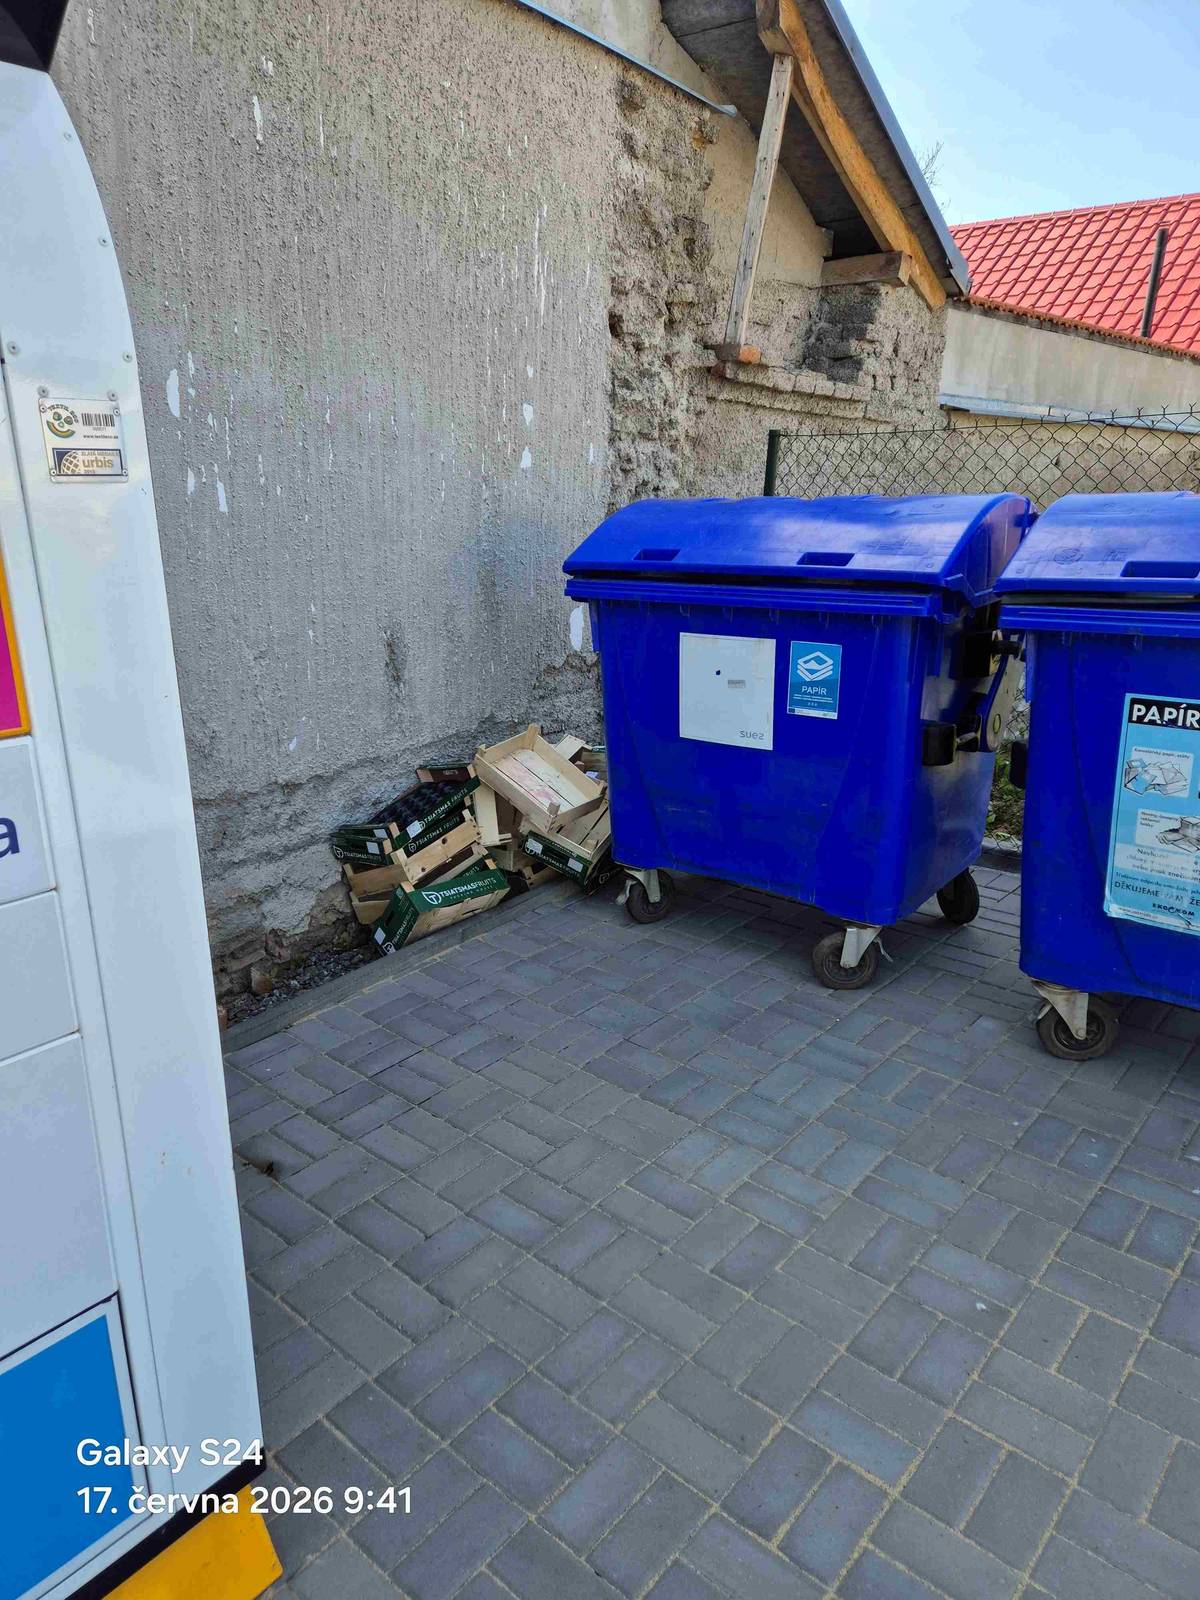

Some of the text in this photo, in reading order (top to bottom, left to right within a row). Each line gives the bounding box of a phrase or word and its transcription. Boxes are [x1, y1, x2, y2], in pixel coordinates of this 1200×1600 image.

[82, 457, 113, 468] urbis
[1132, 703, 1200, 728] PAPÍR
[739, 730, 765, 741] suez
[424, 799, 452, 824] TSIATSMAS
[439, 877, 497, 897] TSIATSMASFRUITS
